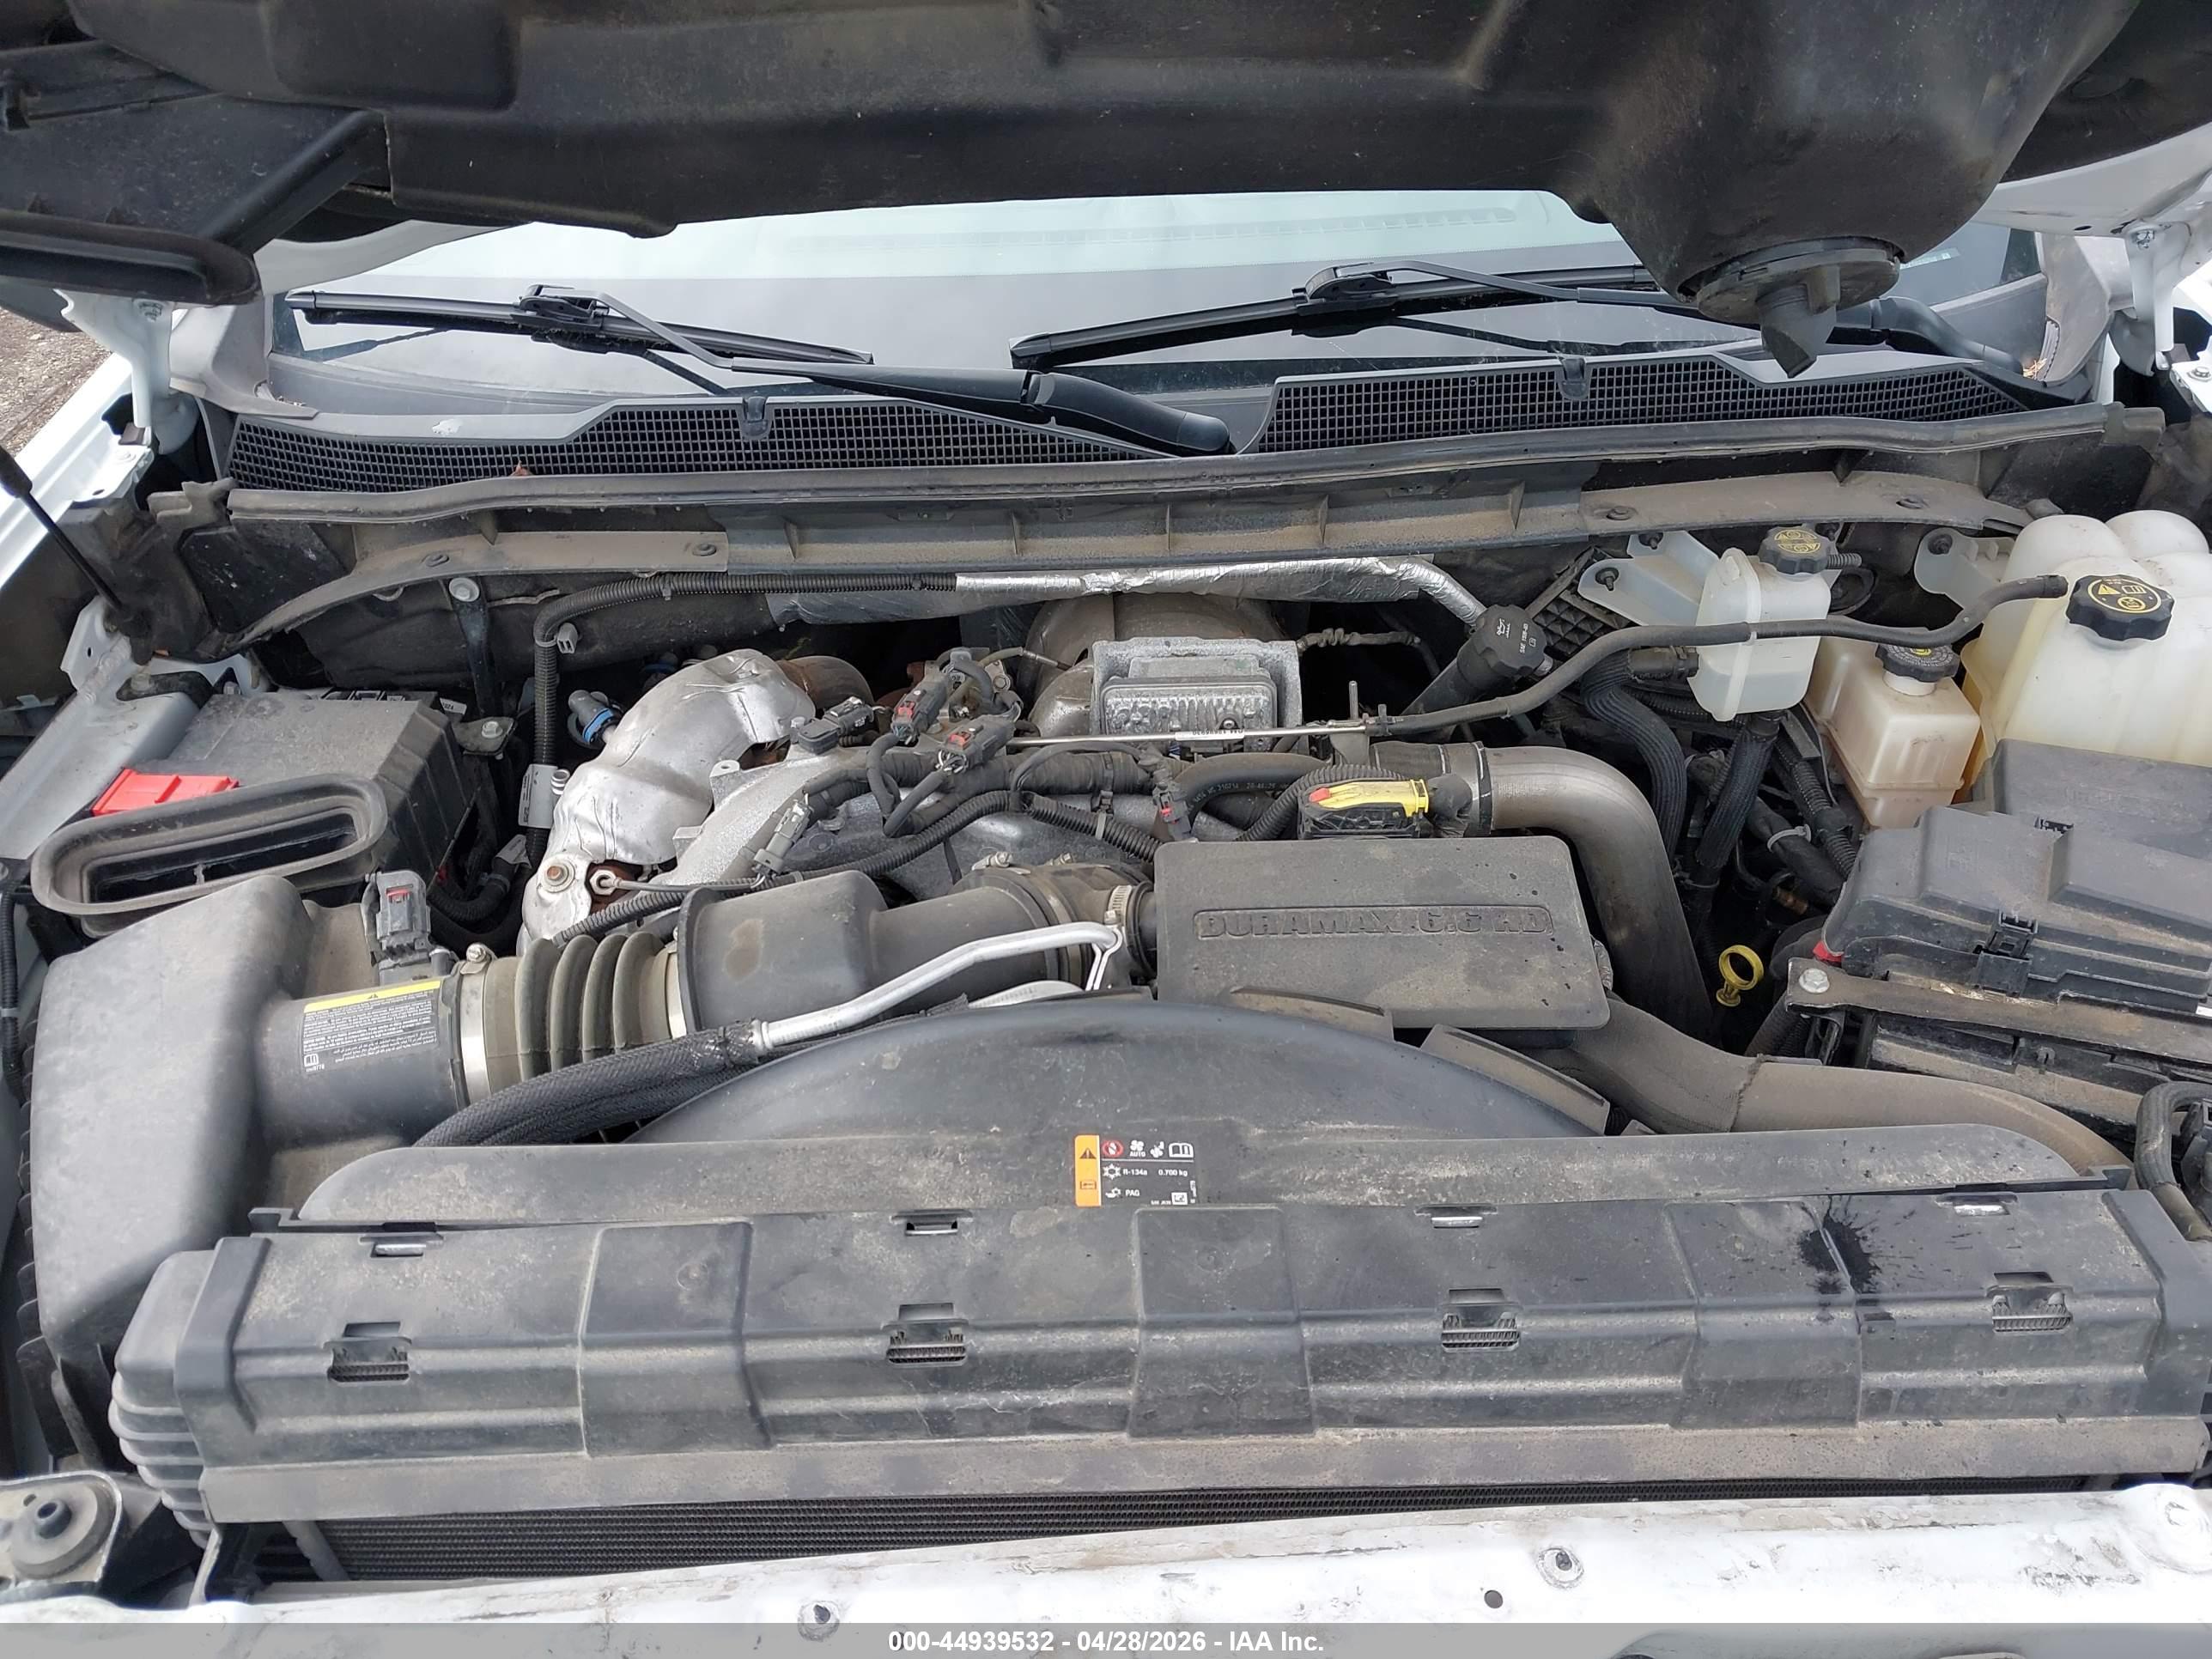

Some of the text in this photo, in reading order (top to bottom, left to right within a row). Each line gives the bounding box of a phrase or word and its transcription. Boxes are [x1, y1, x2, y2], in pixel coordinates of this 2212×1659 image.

[1200, 910, 1402, 938] DURAMAX
[1418, 906, 1482, 933] 6.6
[1178, 1169, 1188, 1177] kg
[1125, 1188, 1140, 1197] PAG
